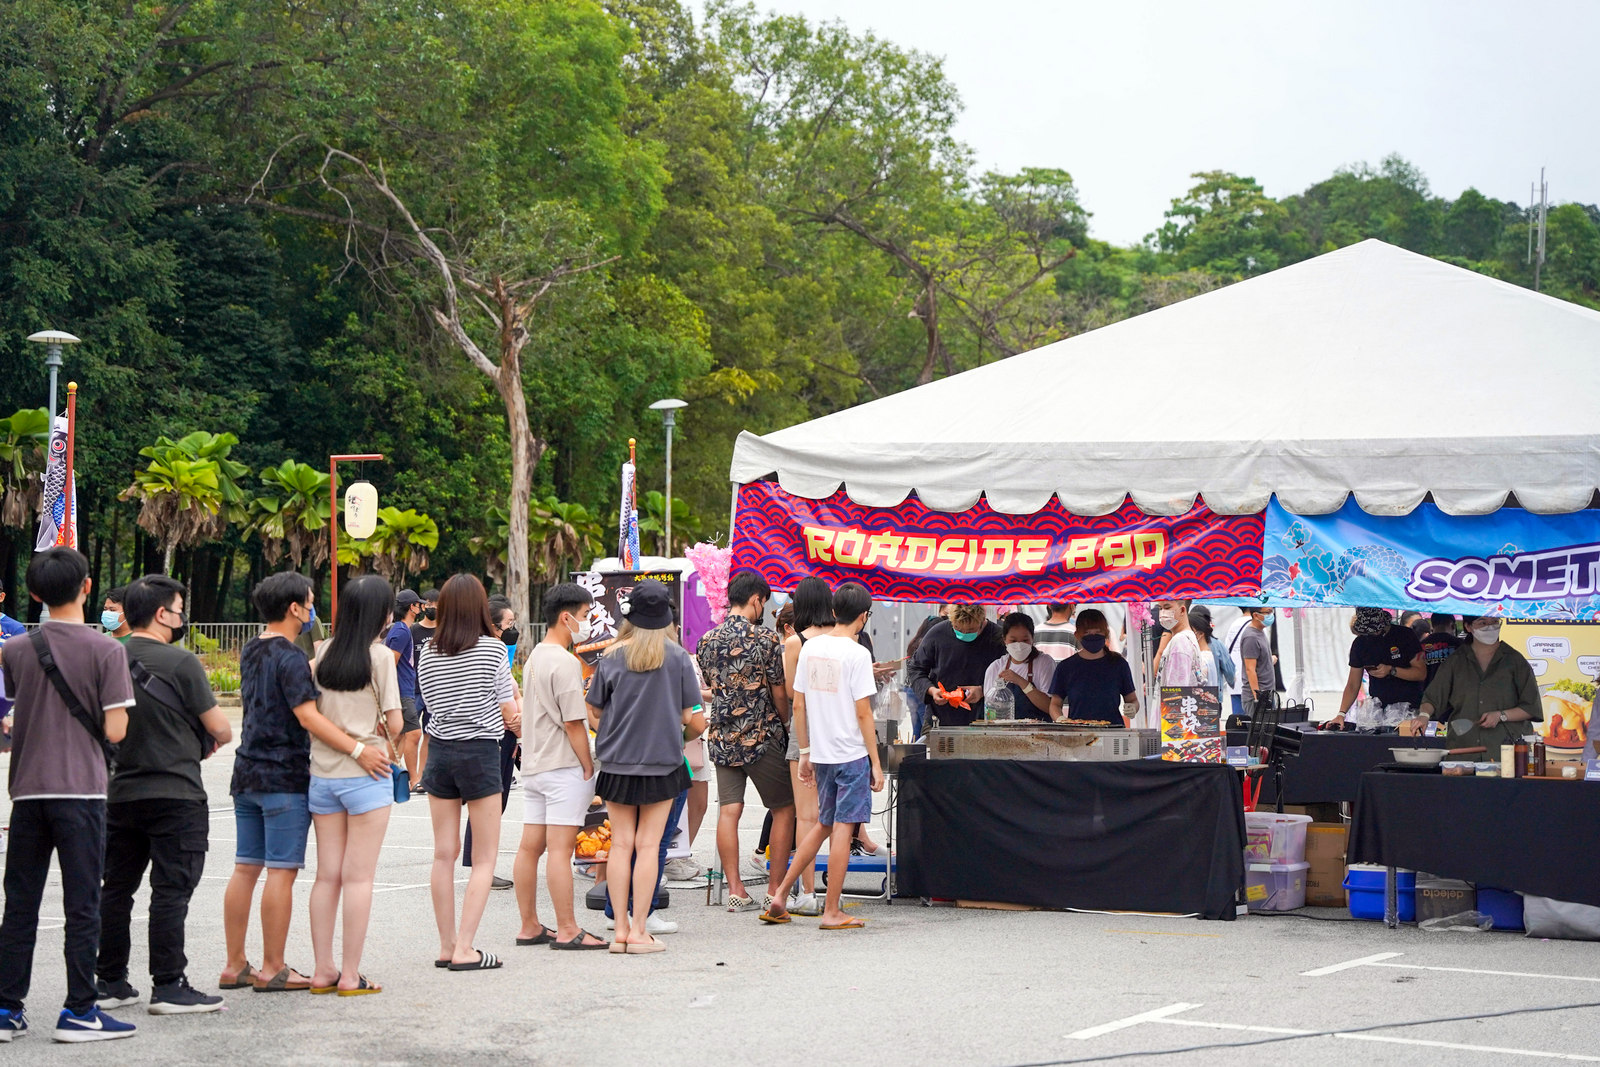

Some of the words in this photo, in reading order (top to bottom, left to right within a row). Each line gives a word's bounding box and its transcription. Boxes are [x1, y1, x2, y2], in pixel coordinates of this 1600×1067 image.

[803, 526, 1048, 573] ROADSIDE
[1062, 531, 1167, 571] BBQ
[1409, 549, 1600, 599] SOMET
[1423, 889, 1464, 900] delecta
